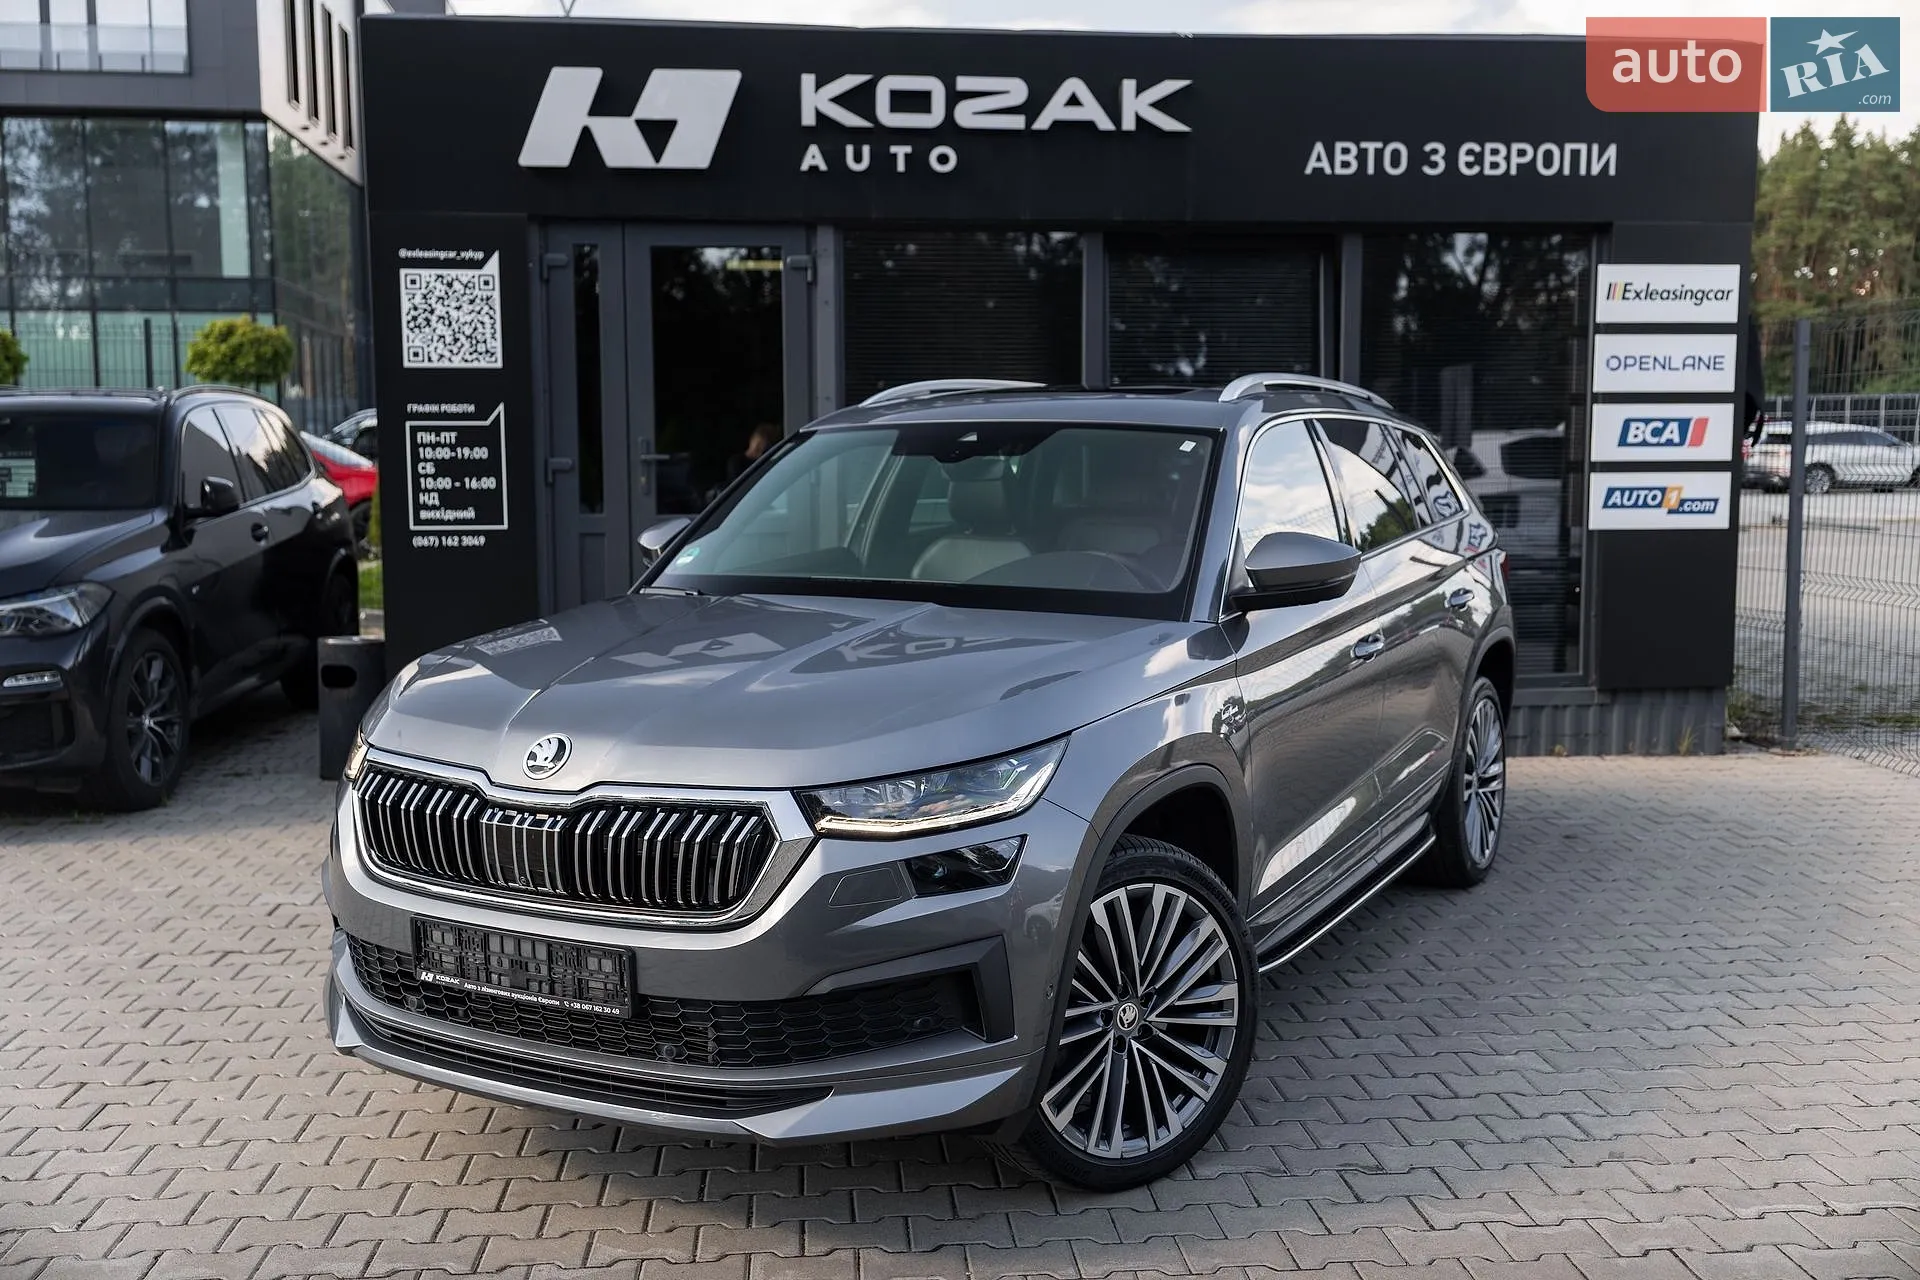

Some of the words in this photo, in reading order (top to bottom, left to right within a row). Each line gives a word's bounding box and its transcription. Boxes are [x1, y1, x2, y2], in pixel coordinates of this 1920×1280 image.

[801, 73, 1193, 132] KOZAK
[801, 144, 958, 173] AUTO
[1304, 141, 1409, 175] АВТО
[1421, 142, 1446, 176] З
[1457, 142, 1618, 177] ЄВРОПИ
[1621, 282, 1734, 306] Exleasingcar
[1606, 355, 1726, 371] OPENLANE
[440, 403, 475, 413] РОБОТИ
[416, 431, 458, 444] ПН-ПТ
[1626, 420, 1681, 444] BCA
[418, 446, 489, 460] 10:00-19:00
[417, 461, 436, 475] СБ
[419, 476, 453, 490] 10:00
[463, 476, 497, 490] 16:00
[419, 491, 440, 507] НД
[419, 507, 476, 522] вихідний
[412, 535, 440, 548] (067)
[441, 535, 460, 547] 162
[463, 982, 478, 991] Авто
[581, 1003, 592, 1011] 067
[603, 1006, 611, 1014] 30
[611, 1007, 620, 1015] 49
